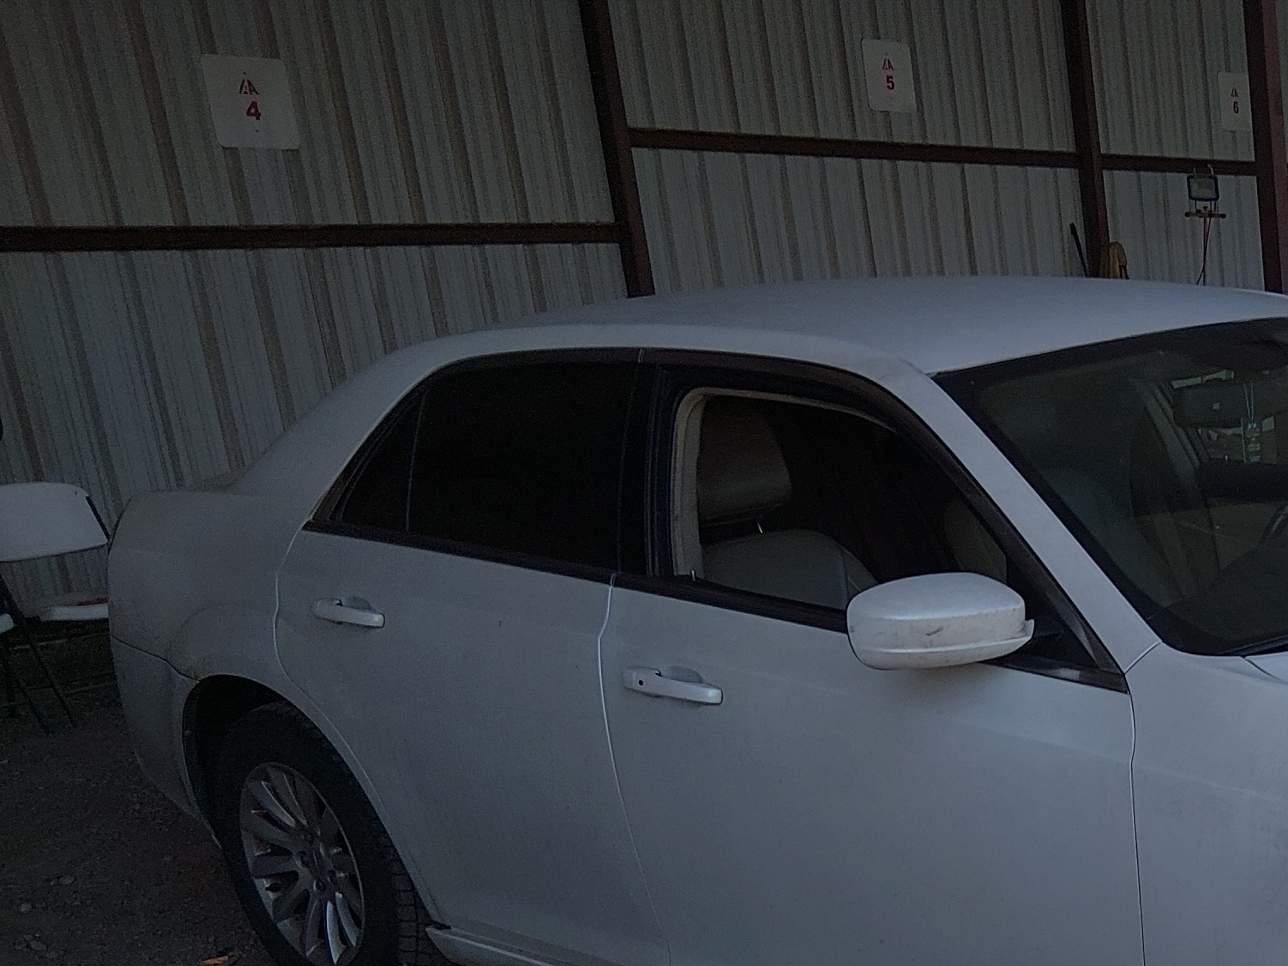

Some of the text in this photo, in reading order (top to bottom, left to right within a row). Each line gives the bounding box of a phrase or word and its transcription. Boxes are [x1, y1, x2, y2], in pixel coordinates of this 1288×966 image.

[886, 75, 895, 90] 5
[246, 101, 262, 120] 4
[1233, 101, 1239, 114] 6
